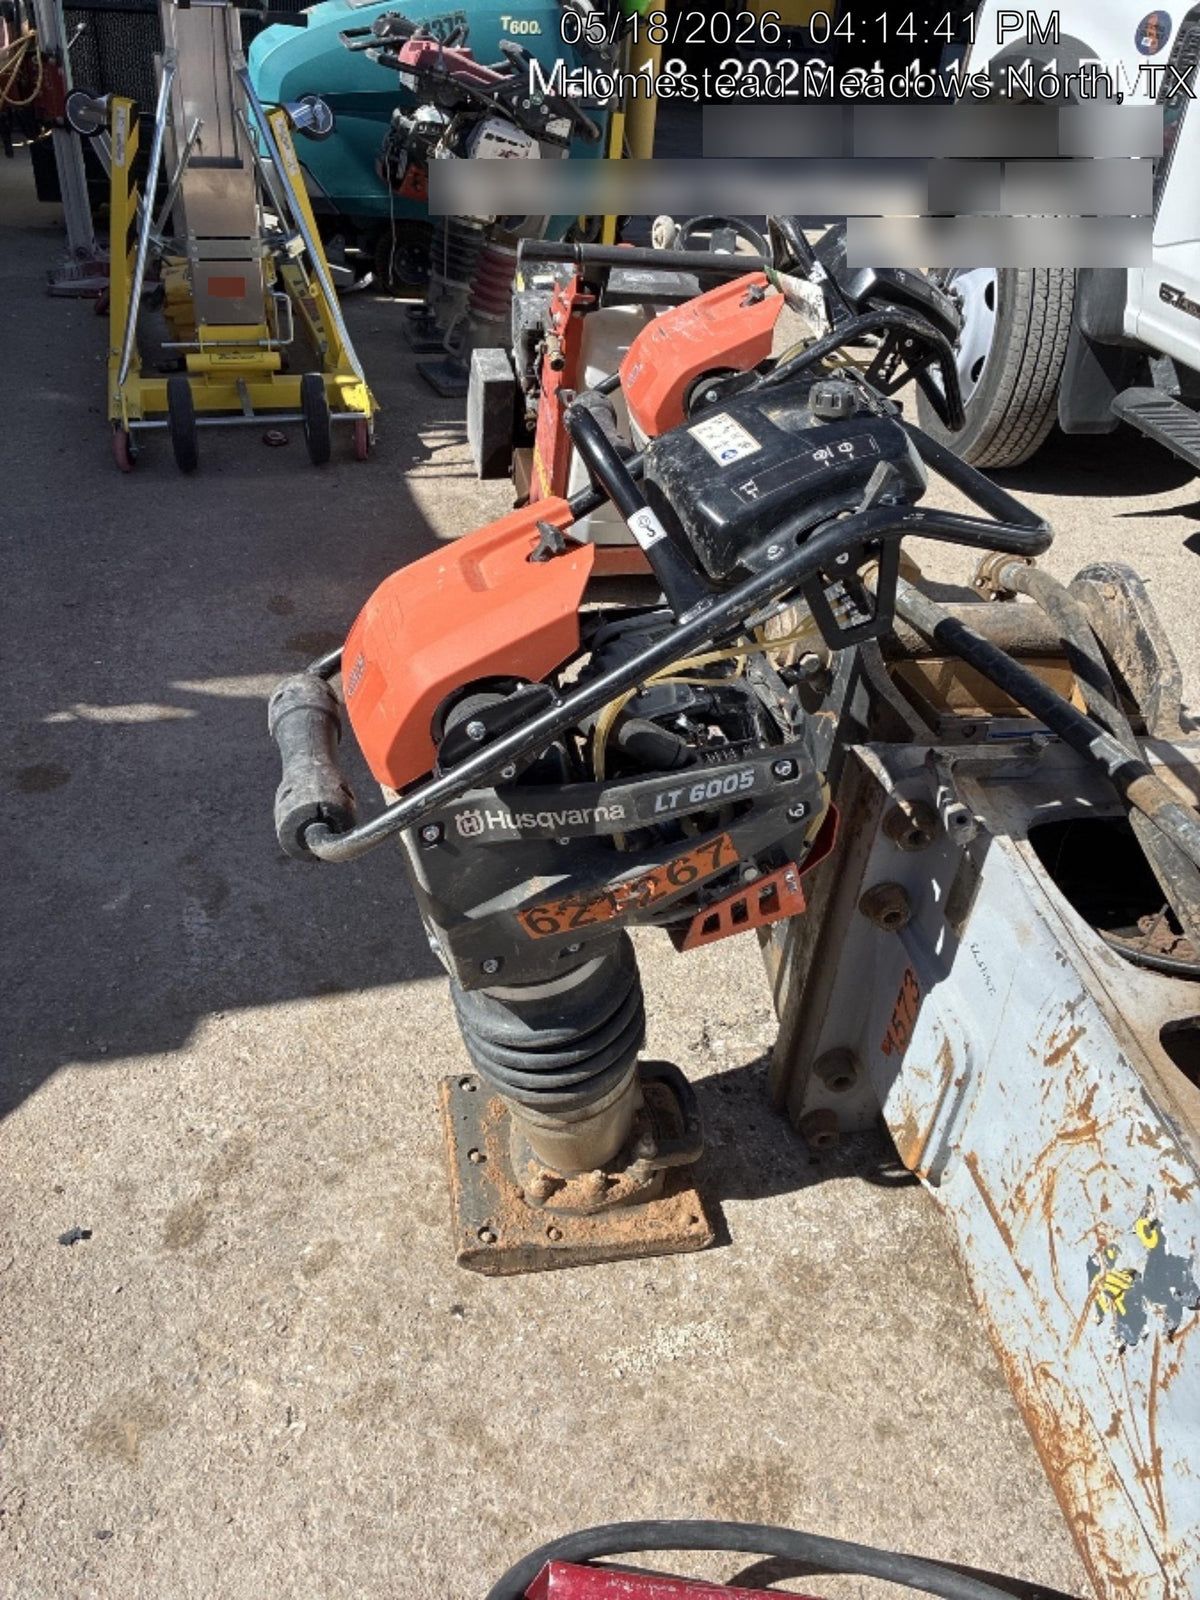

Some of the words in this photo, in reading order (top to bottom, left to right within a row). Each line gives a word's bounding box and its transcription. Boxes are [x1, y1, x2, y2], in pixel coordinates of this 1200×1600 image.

[654, 789, 684, 813] LT
[689, 768, 756, 803] 6005
[485, 803, 626, 833] Husqvarna
